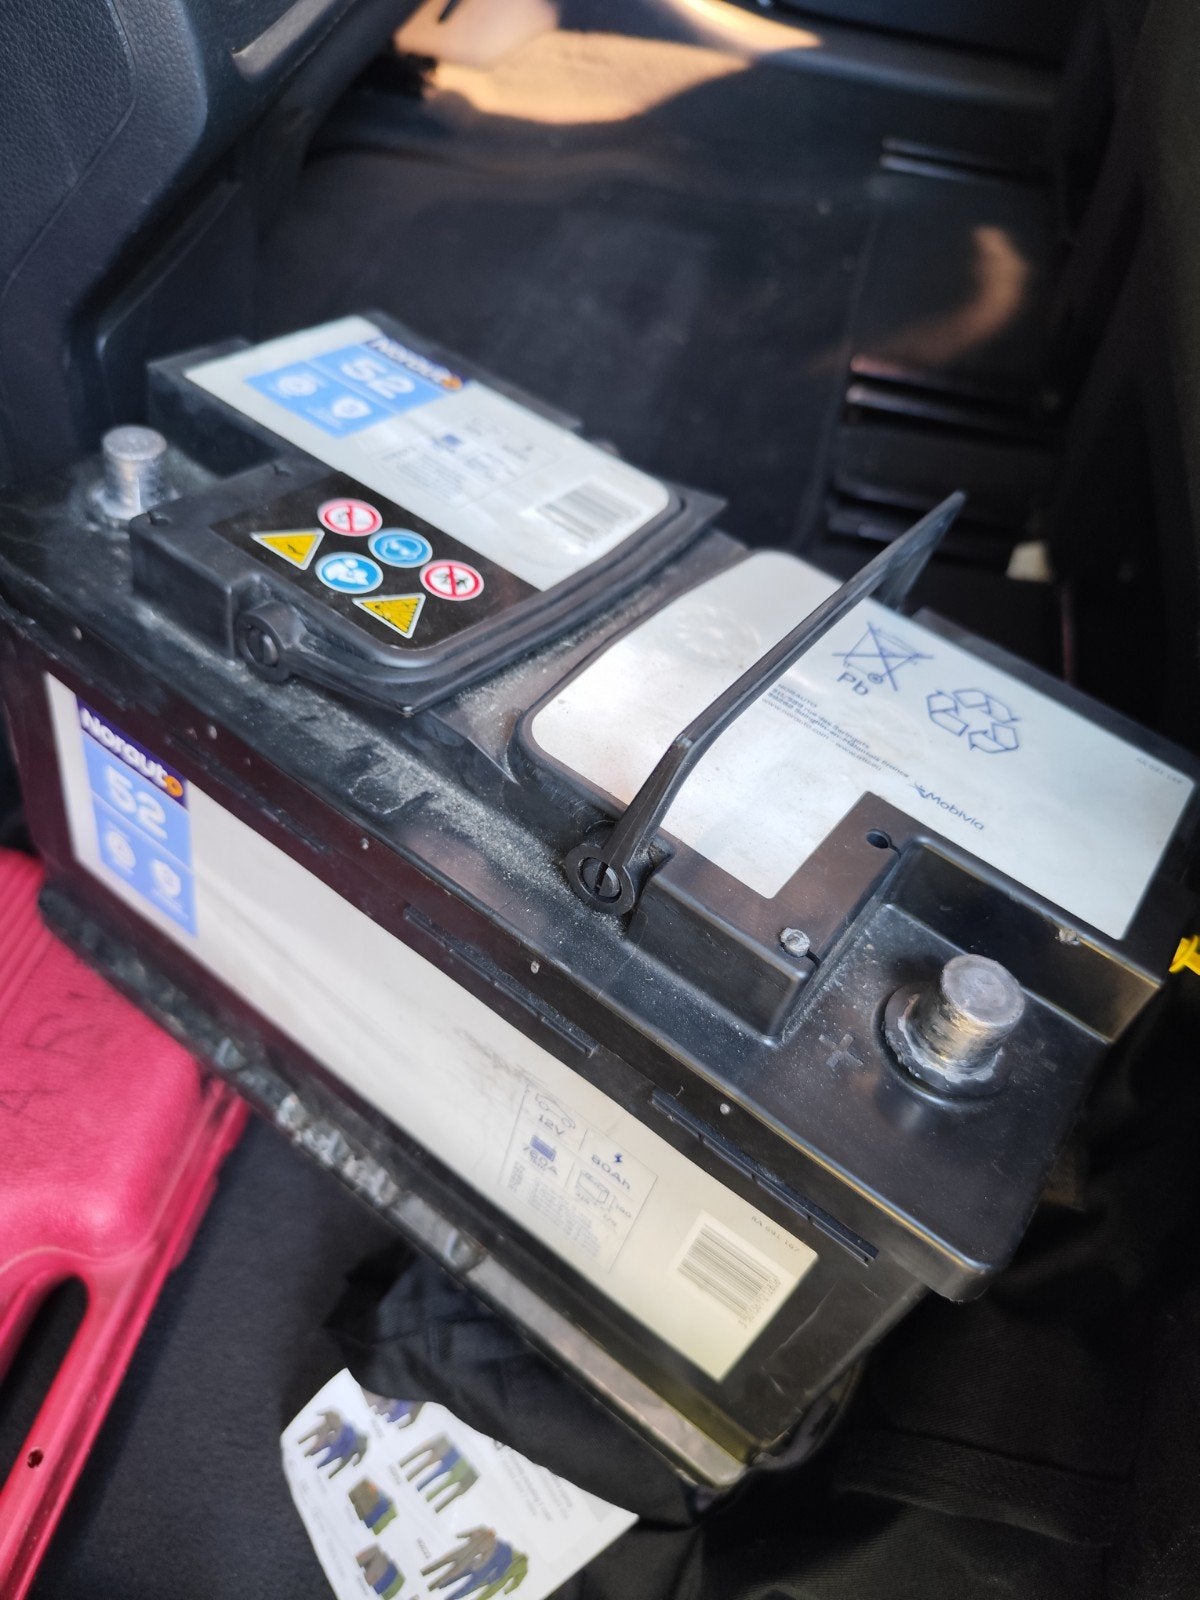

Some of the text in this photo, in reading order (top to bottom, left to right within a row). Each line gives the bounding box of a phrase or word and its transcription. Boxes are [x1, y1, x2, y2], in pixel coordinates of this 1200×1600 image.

[837, 671, 869, 696] Pb
[81, 706, 184, 798] Norauto
[925, 791, 985, 831] Mobivia
[538, 1112, 565, 1138] 12V
[590, 1153, 632, 1190] 80Ah
